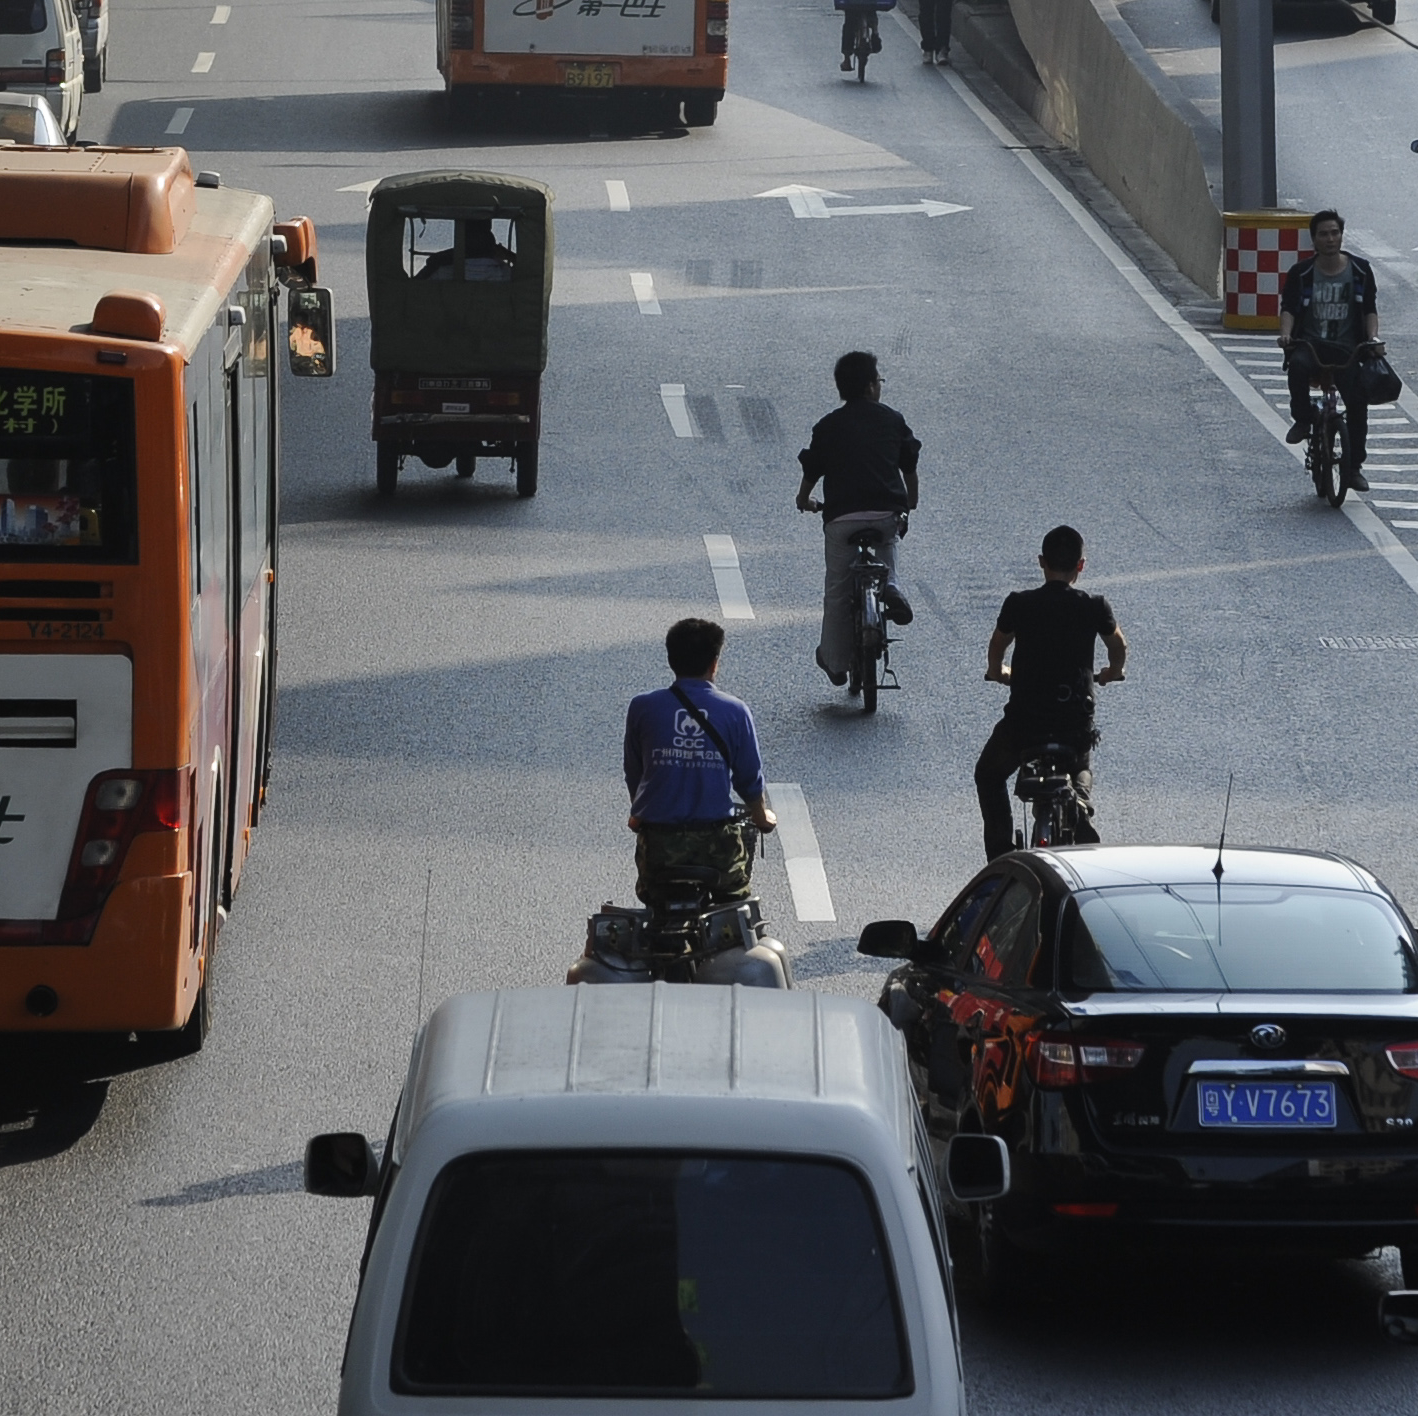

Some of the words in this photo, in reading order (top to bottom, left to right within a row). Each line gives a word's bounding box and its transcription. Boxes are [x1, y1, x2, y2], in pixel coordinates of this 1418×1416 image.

[567, 72, 612, 87] B9197
[27, 622, 105, 639] Y4-2124
[673, 736, 705, 749] GGC
